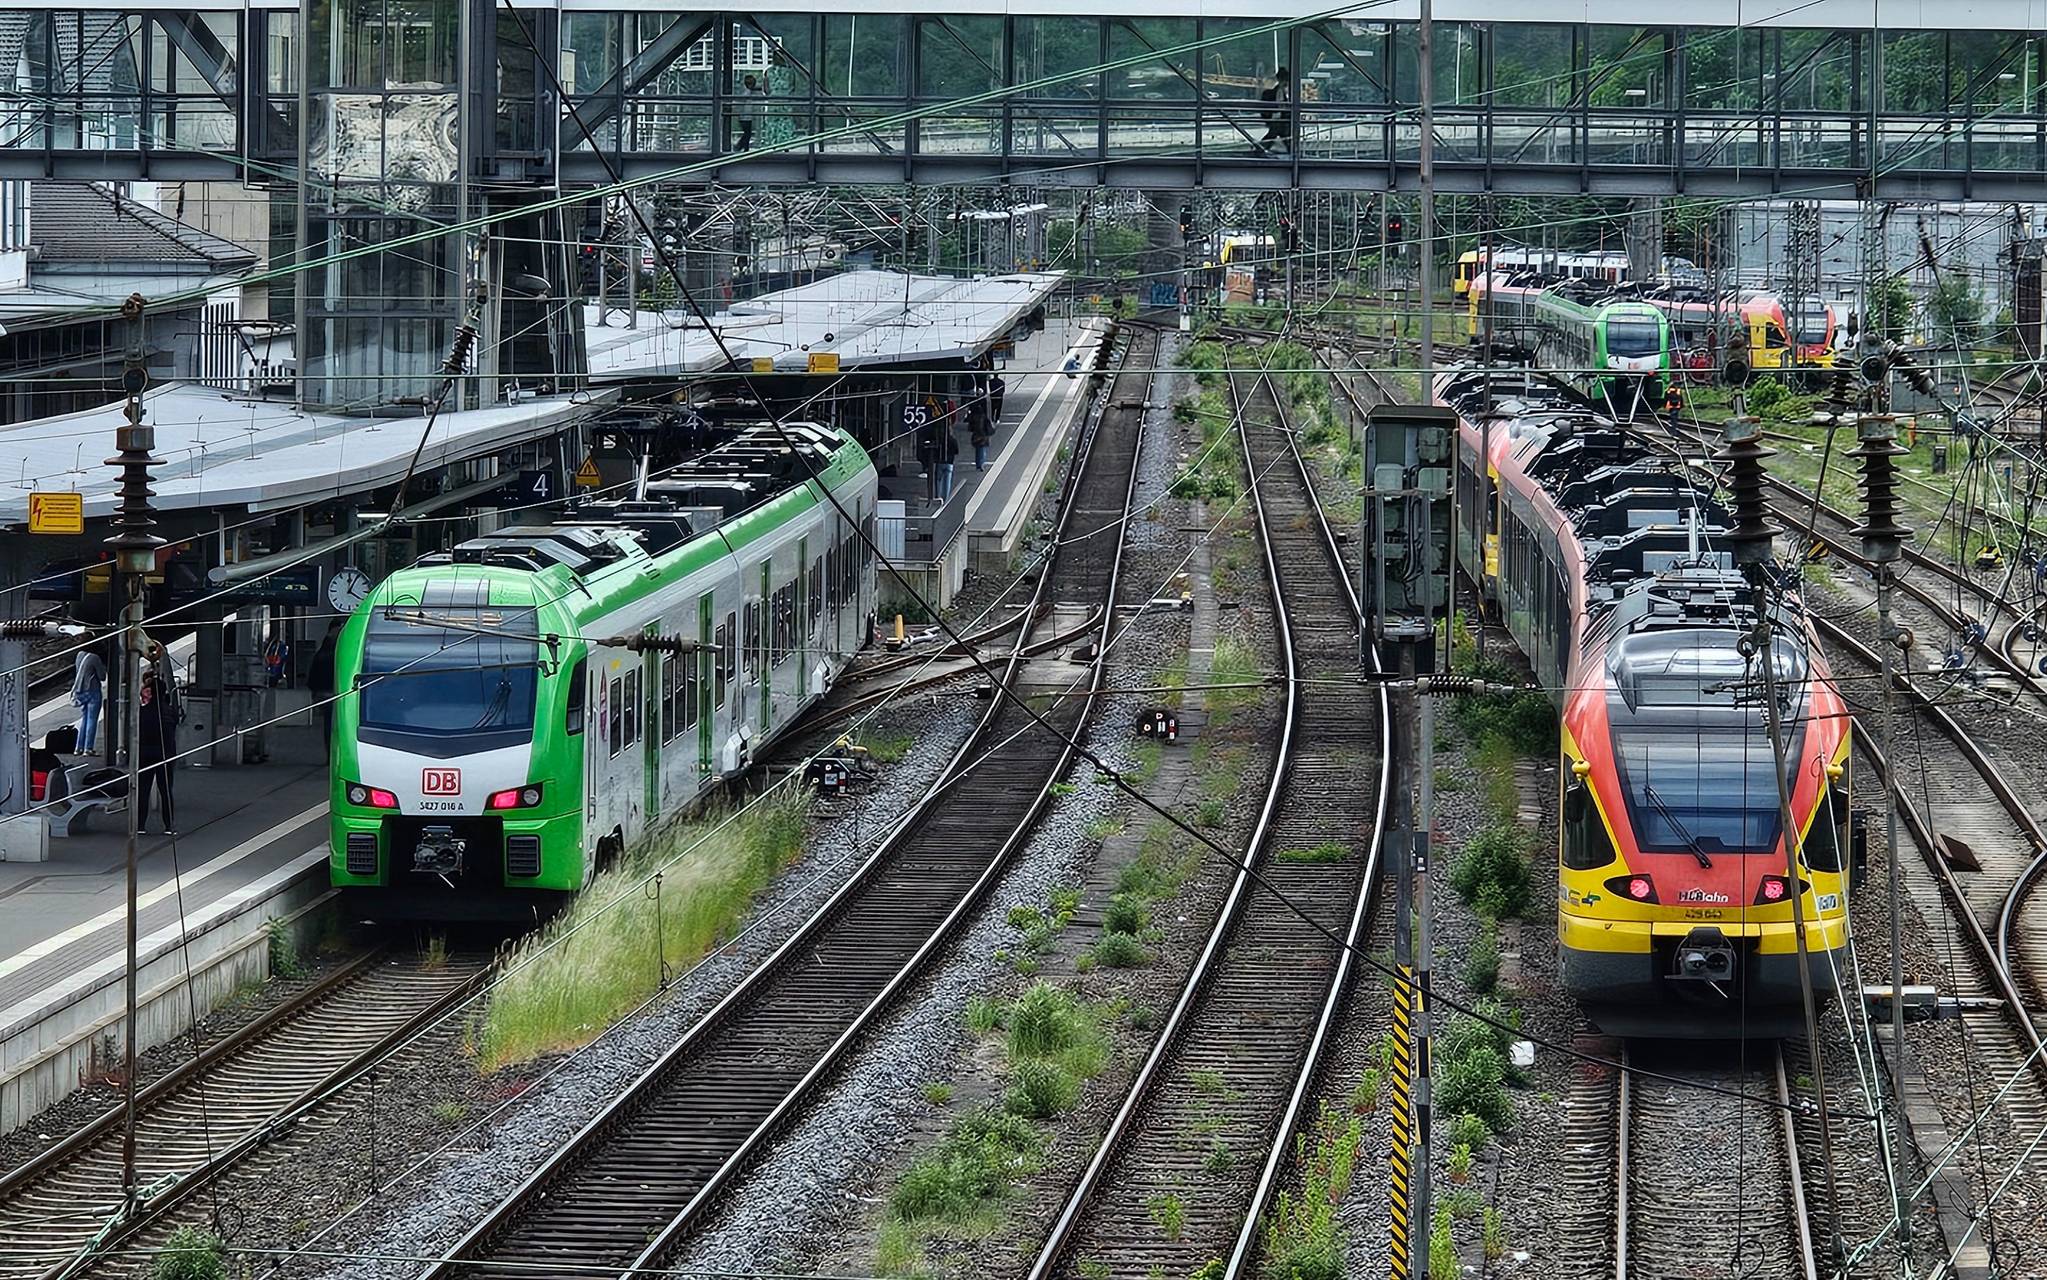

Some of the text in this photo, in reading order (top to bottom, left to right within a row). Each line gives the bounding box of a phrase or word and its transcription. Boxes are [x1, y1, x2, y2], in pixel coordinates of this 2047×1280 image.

[903, 406, 926, 424] 55
[532, 473, 548, 497] 4
[427, 772, 457, 791] DB
[457, 801, 465, 811] A
